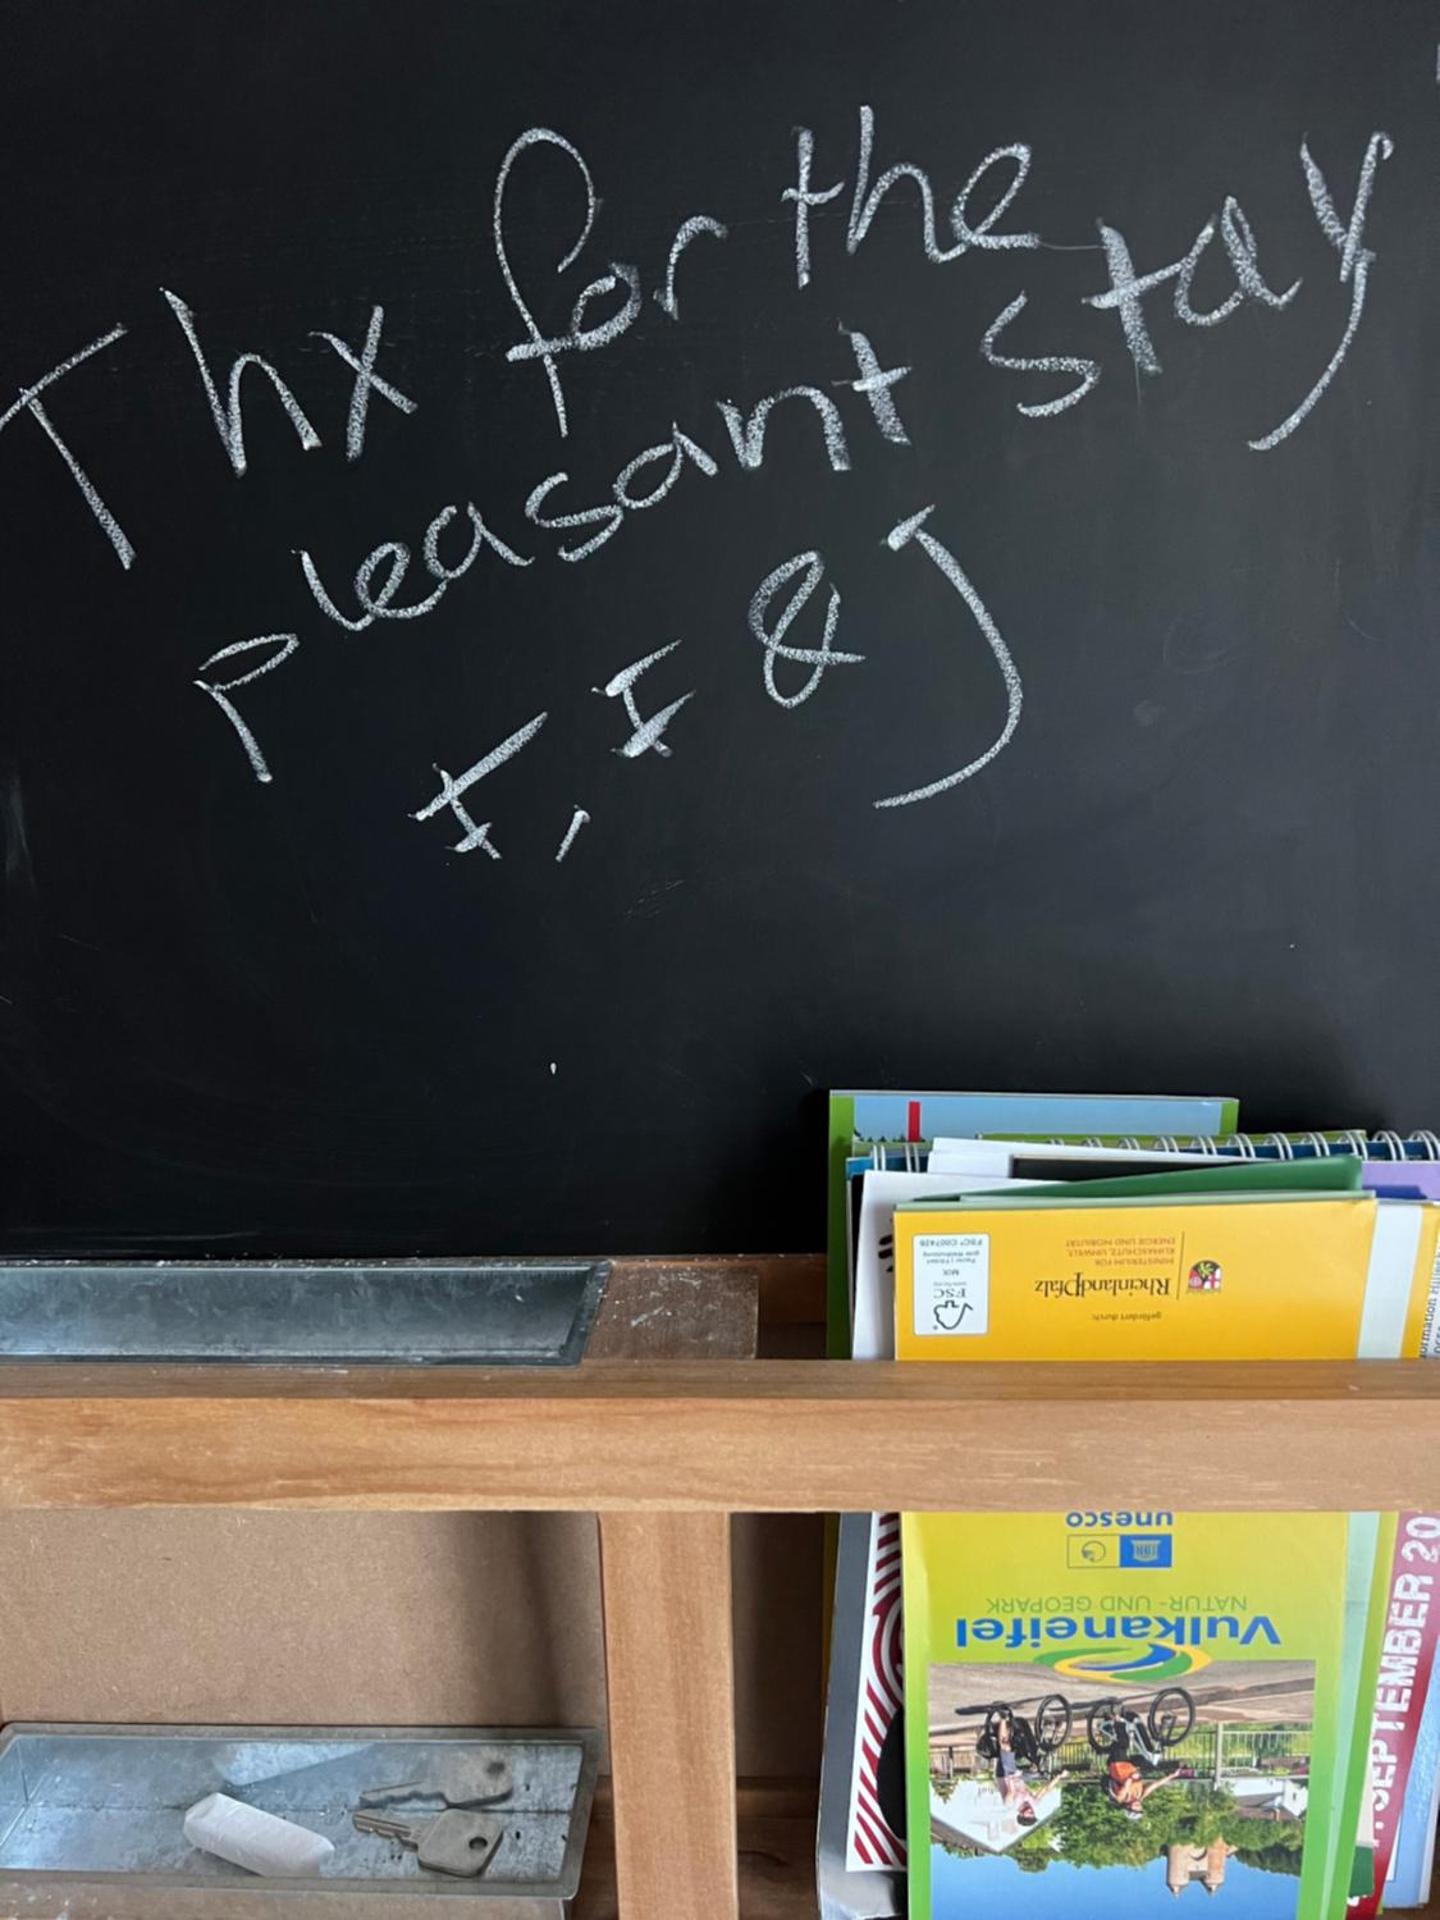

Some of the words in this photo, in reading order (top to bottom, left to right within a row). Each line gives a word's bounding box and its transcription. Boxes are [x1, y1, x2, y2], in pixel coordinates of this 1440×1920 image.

[980, 131, 1394, 452] stay
[0, 287, 418, 569] Thx
[494, 127, 728, 438] for
[781, 105, 1041, 290] the
[748, 552, 866, 708] &
[874, 504, 1024, 807] J
[1065, 1511, 1174, 1528] unesco
[985, 1595, 1093, 1615] GEOPARK
[1100, 1595, 1152, 1613] UND
[1158, 1595, 1248, 1612] NATUR-
[956, 1615, 1282, 1649] Vulkaneifel
